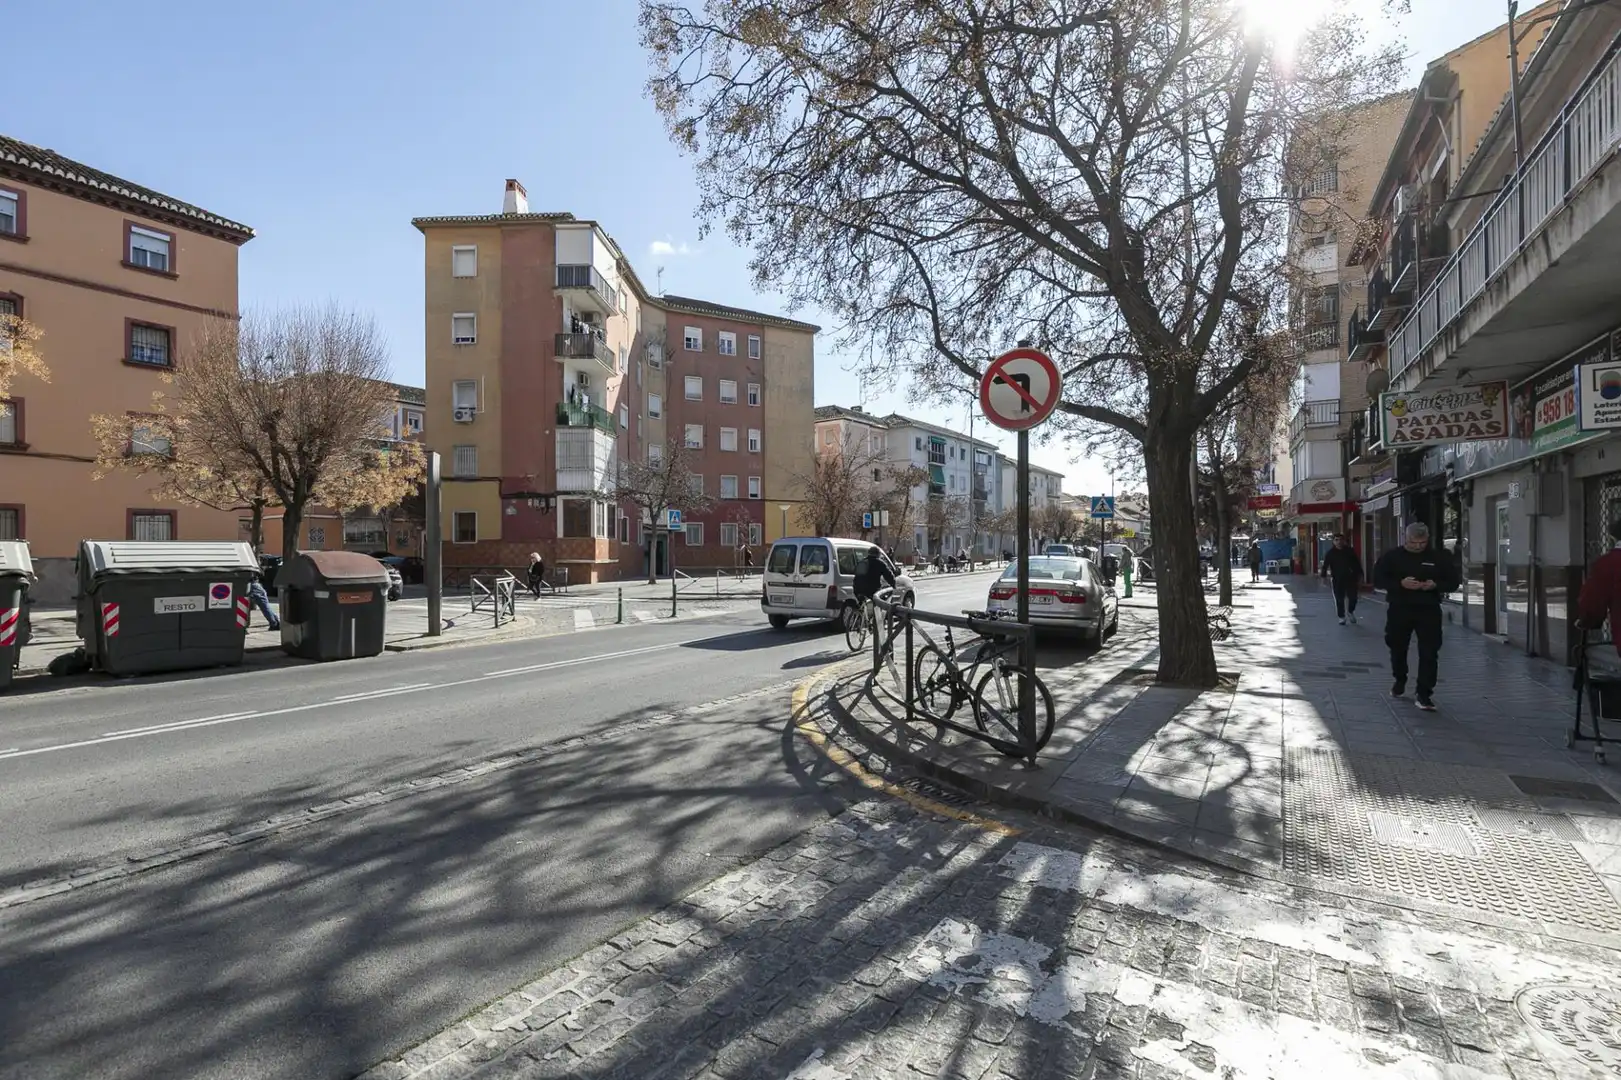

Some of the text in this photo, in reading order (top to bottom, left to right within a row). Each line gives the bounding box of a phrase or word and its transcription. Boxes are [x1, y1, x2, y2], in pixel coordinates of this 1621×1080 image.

[1396, 409, 1494, 429] PATATAS
[1543, 395, 1561, 425] 958
[1391, 420, 1502, 443] ASADAS
[163, 603, 197, 612] RESTO
